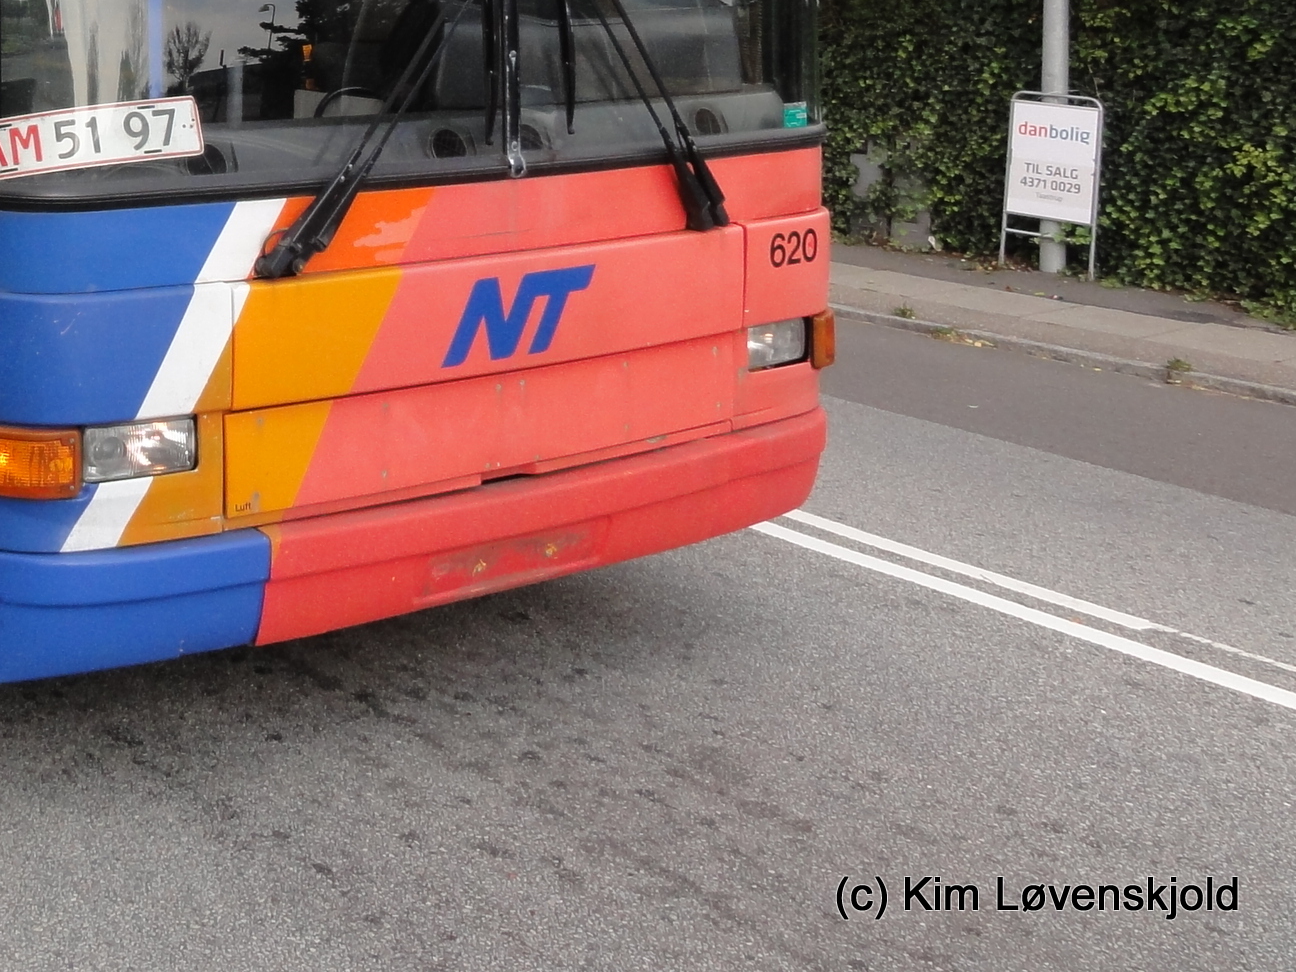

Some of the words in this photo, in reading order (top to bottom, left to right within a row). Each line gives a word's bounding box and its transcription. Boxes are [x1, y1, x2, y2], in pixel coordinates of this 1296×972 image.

[53, 116, 101, 159] 51
[123, 108, 176, 150] 97
[1018, 121, 1091, 145] danbolig
[1020, 176, 1047, 189] 4371
[1050, 180, 1081, 194] 0029
[1024, 162, 1042, 175] TIL
[1045, 165, 1079, 180] SALG
[769, 228, 818, 268] 620
[441, 264, 597, 369] NT
